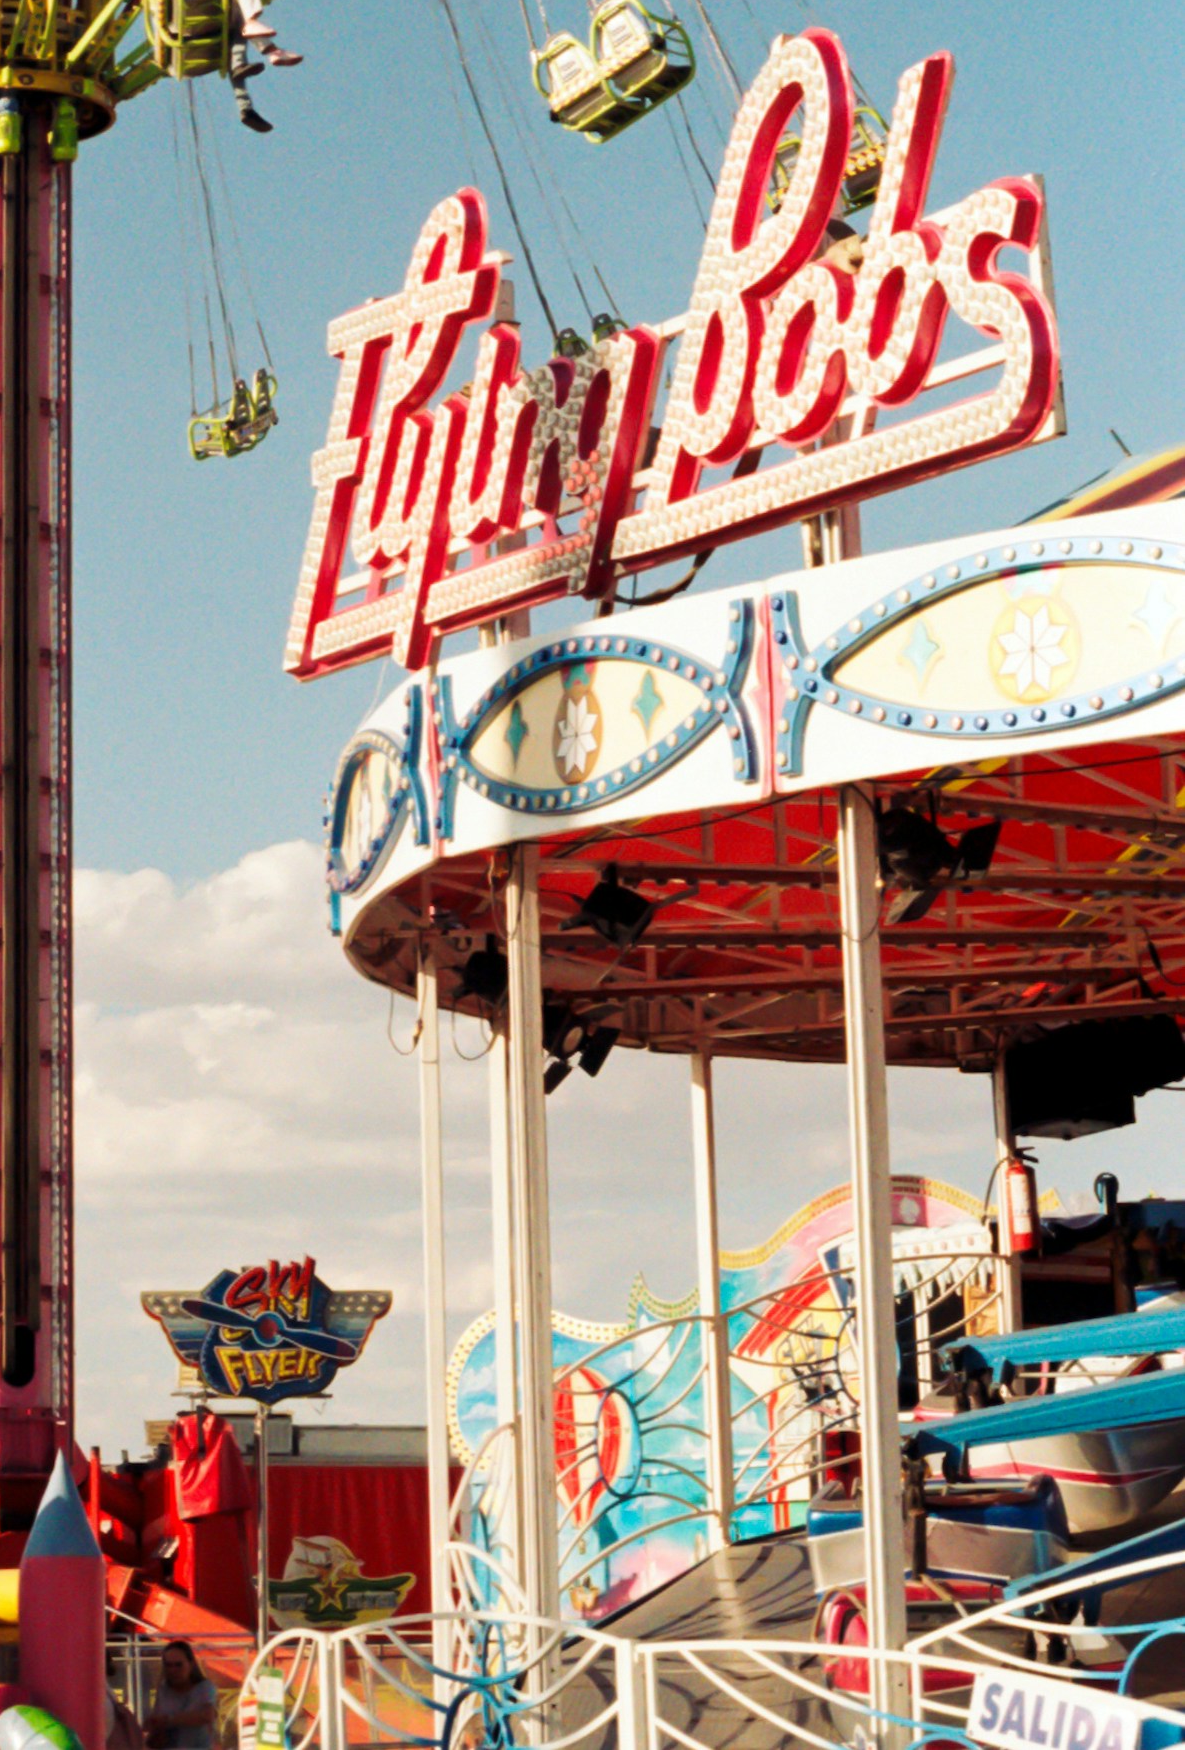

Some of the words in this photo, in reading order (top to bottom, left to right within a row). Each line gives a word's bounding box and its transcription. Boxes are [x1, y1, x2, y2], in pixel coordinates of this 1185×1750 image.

[286, 186, 662, 682] Flying
[611, 21, 1059, 560] Bobs
[221, 1253, 315, 1343] SKY
[979, 1682, 1124, 1750] SALIDA
